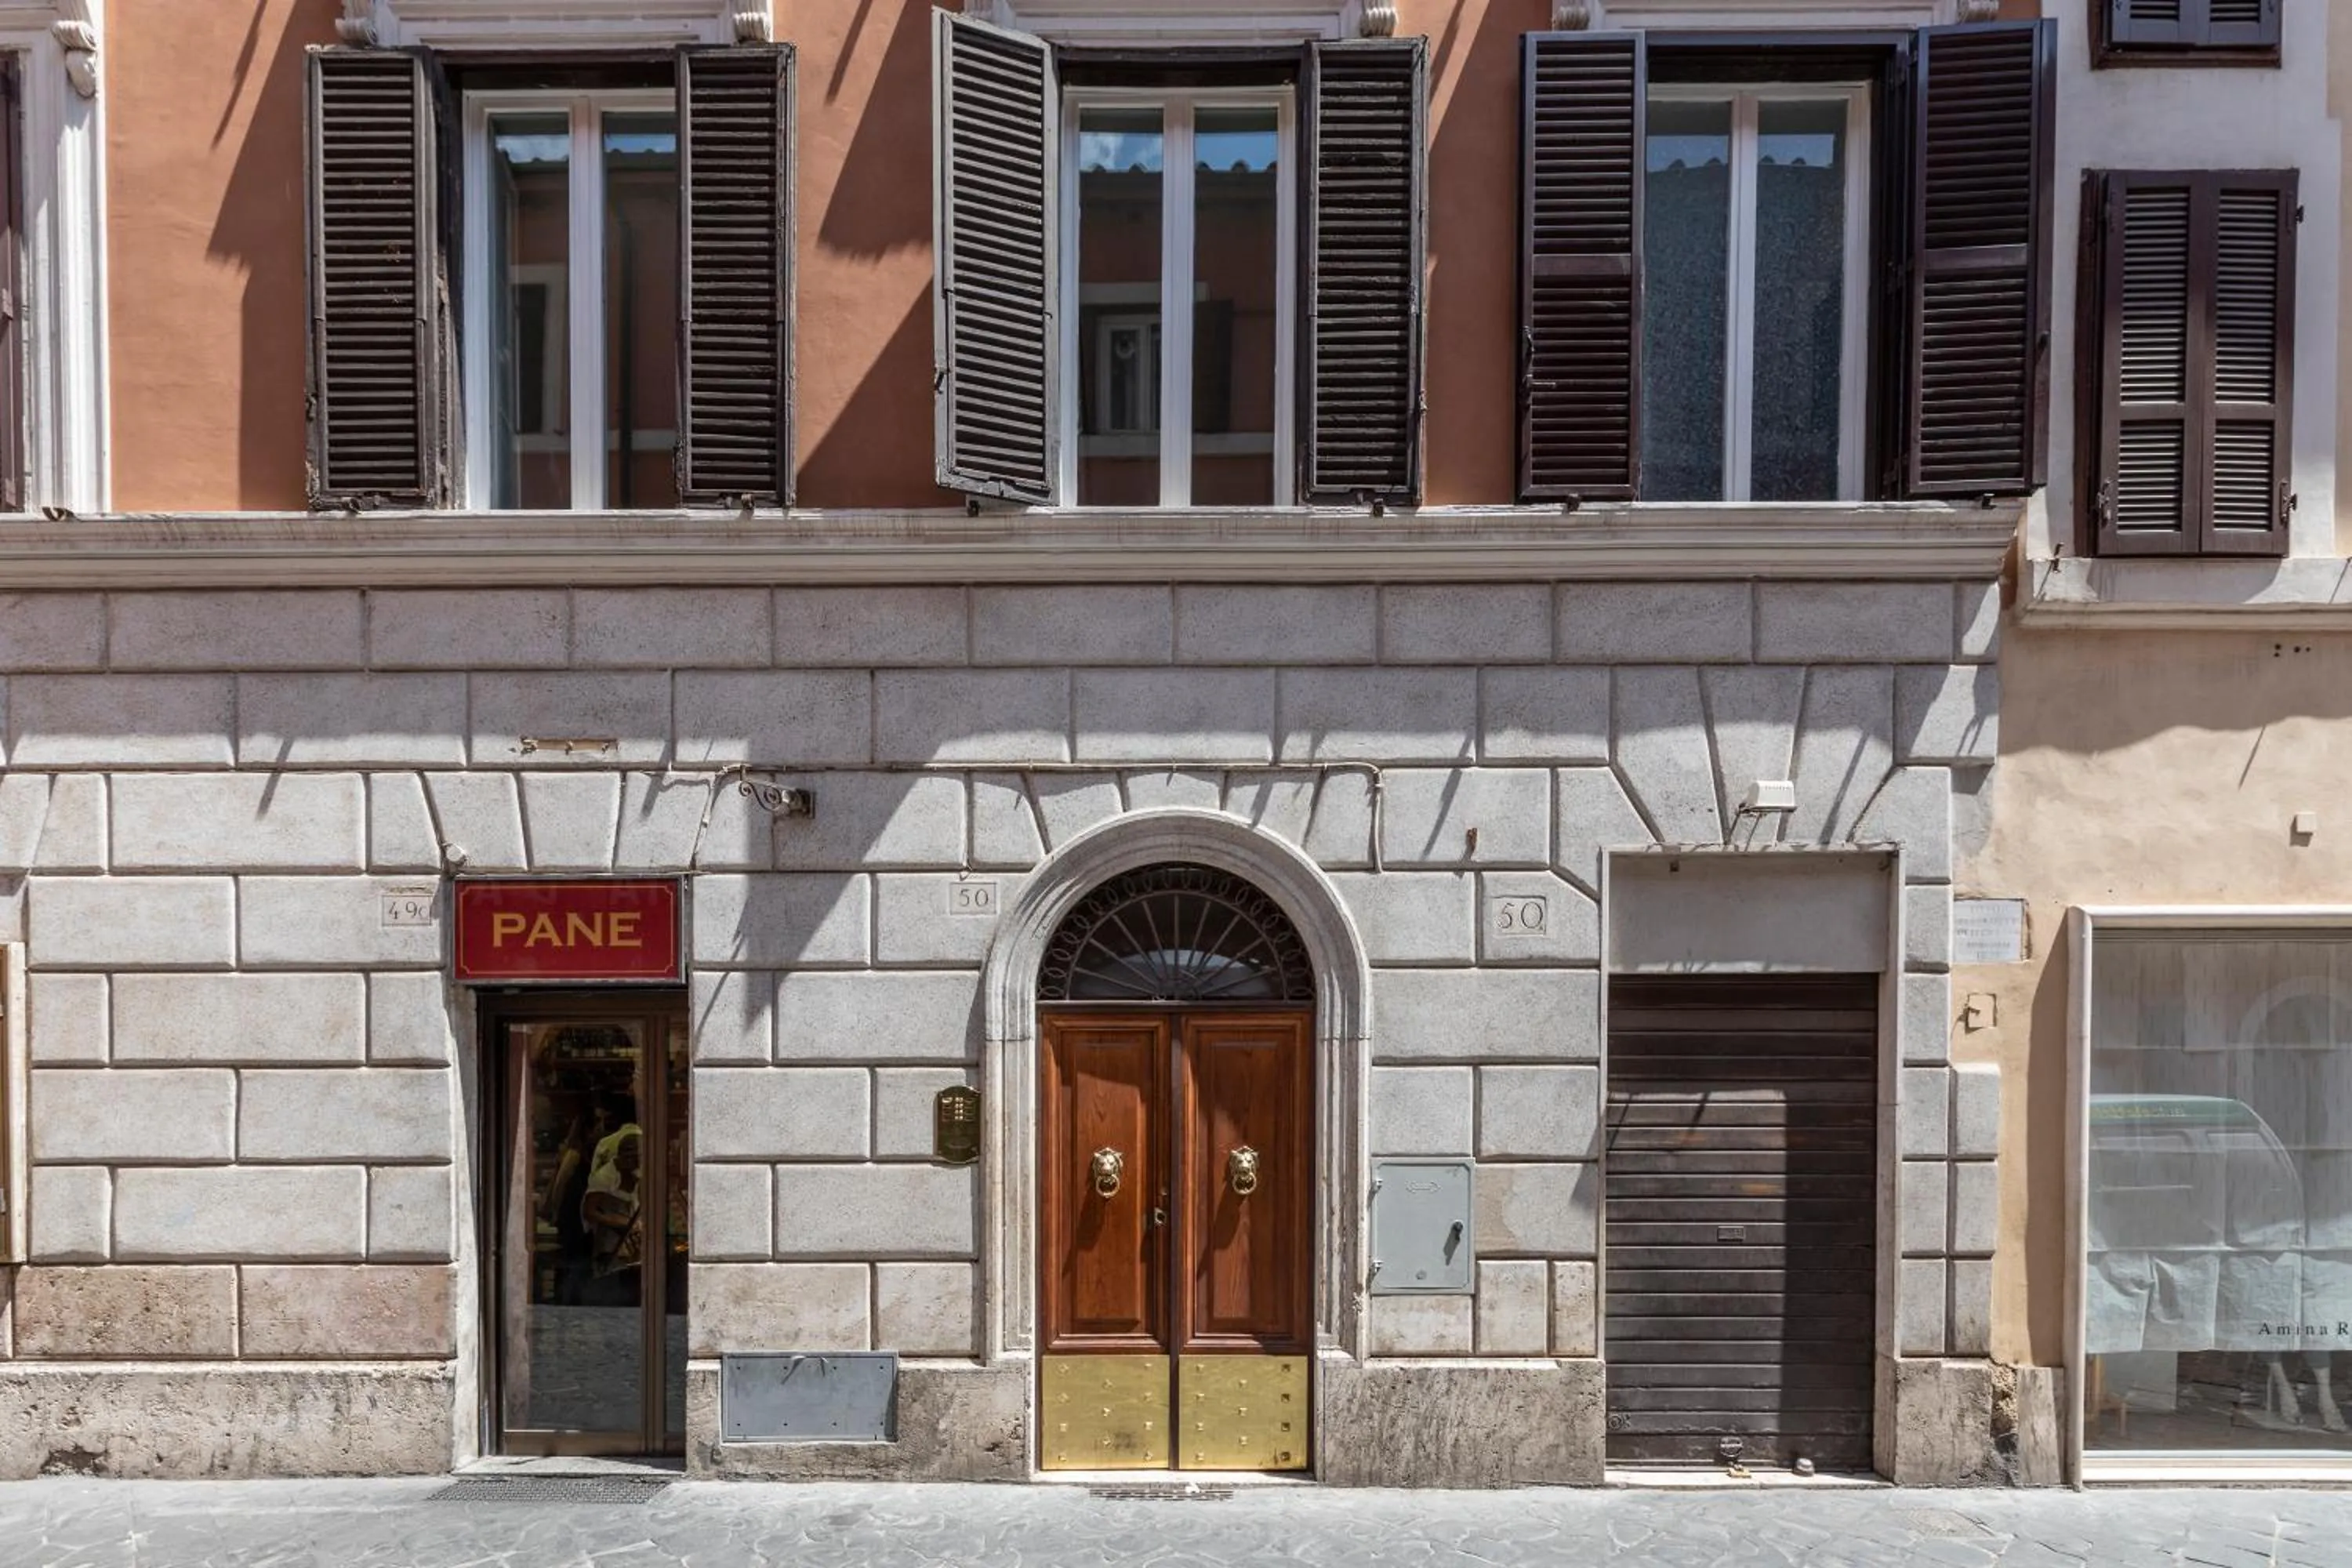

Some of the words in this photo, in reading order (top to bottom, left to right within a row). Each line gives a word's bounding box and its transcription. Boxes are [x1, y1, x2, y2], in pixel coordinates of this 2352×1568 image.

[959, 888, 989, 906] 50
[492, 913, 642, 947] PANE
[2258, 1323, 2328, 1335] Amina
